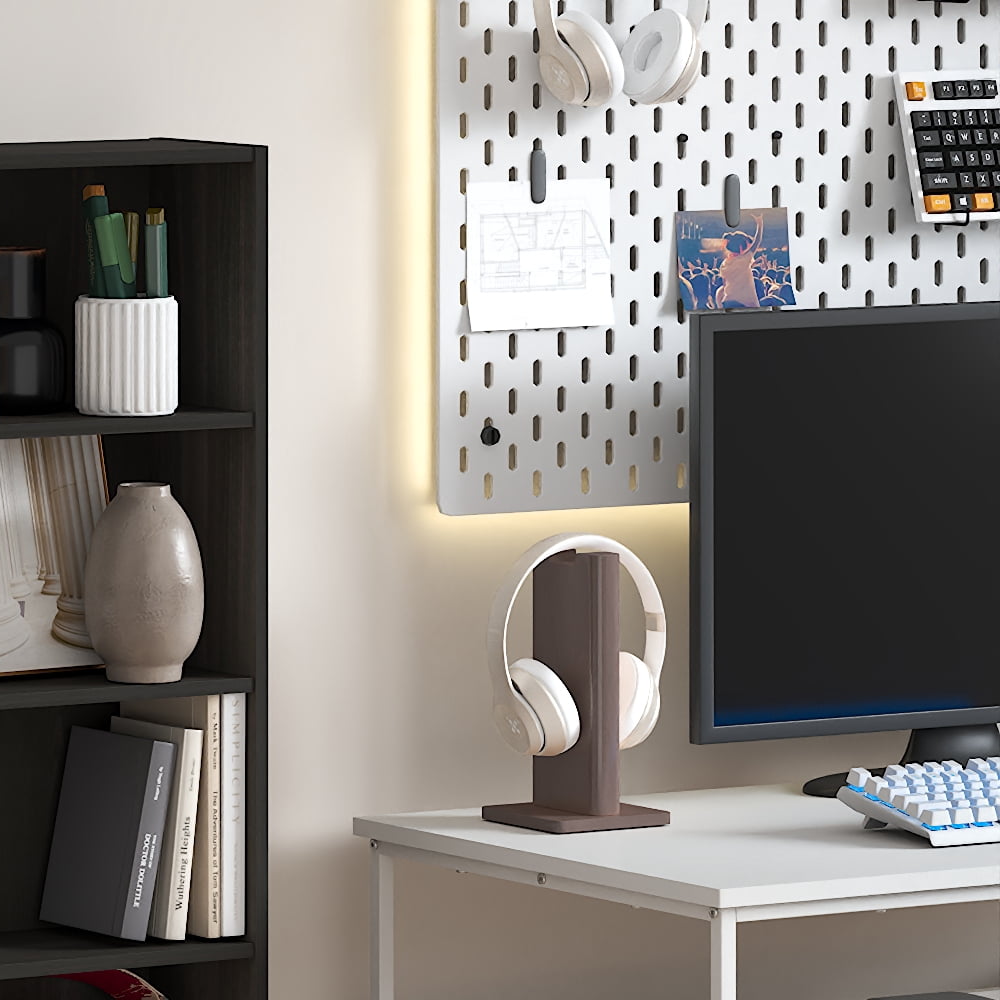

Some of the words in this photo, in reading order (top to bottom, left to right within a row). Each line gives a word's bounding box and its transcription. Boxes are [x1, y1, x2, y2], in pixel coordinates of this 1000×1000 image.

[139, 833, 152, 867] DOCTOR
[180, 816, 191, 854] Heights
[175, 857, 188, 911] Wuthering
